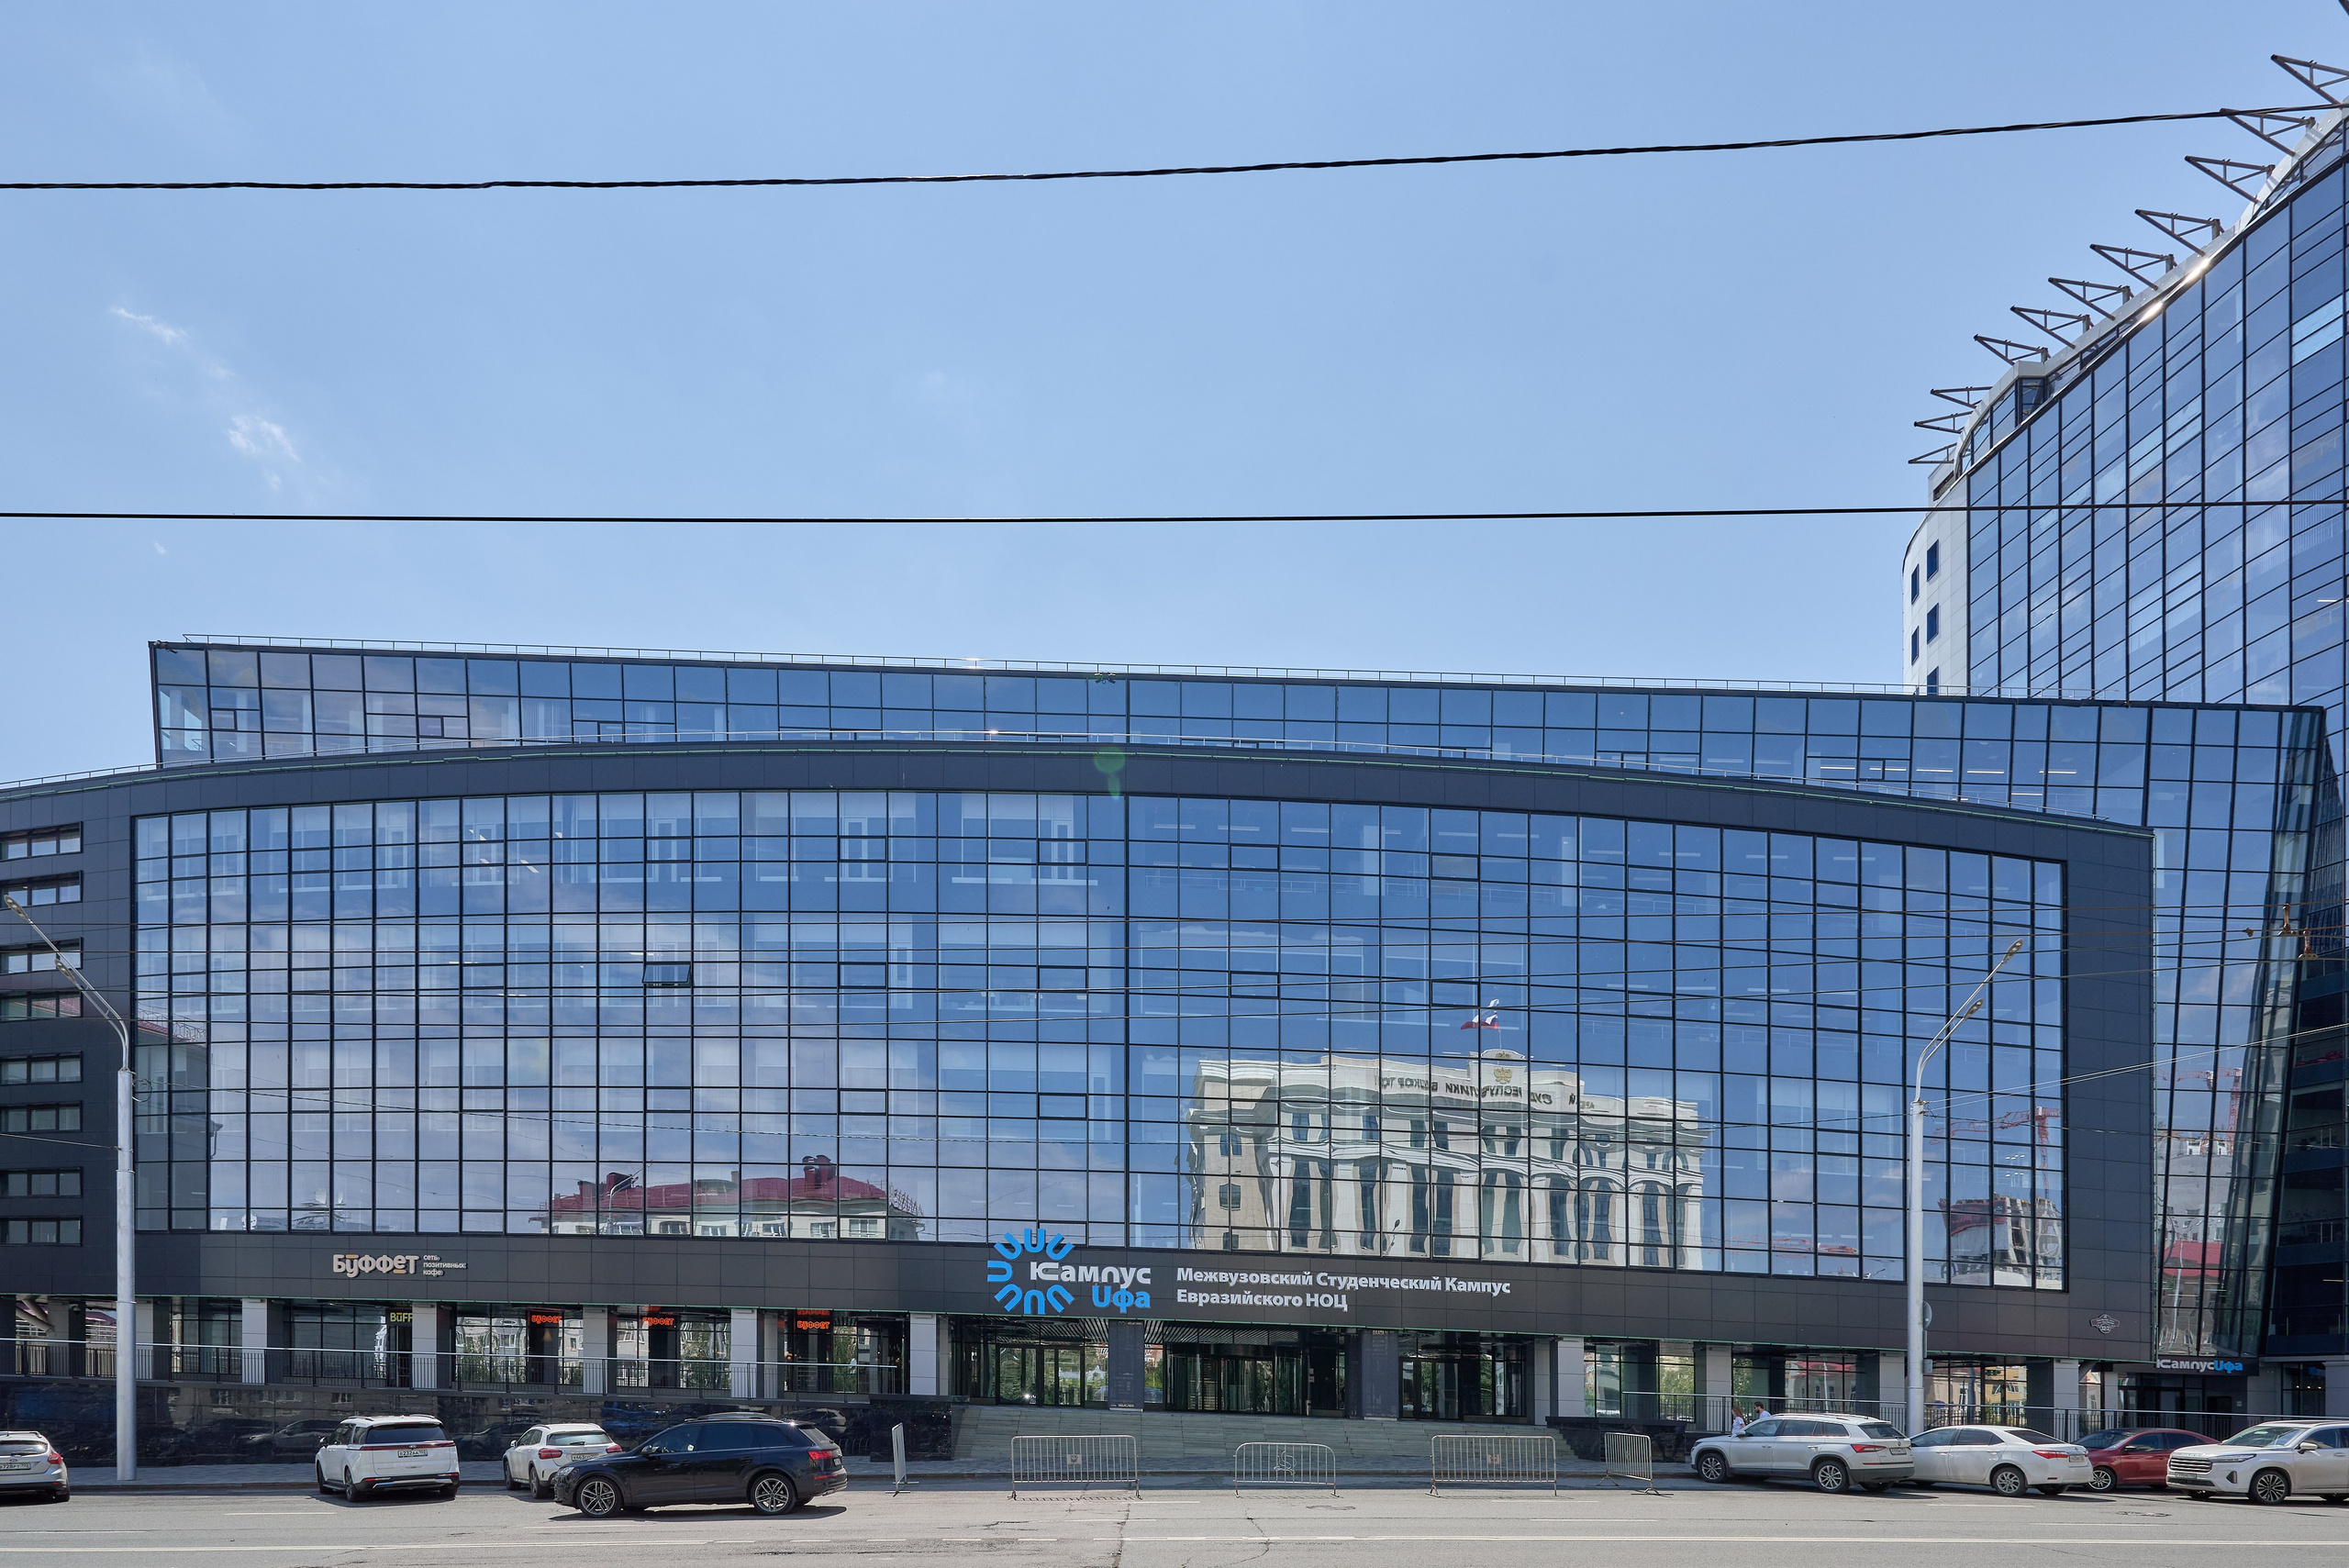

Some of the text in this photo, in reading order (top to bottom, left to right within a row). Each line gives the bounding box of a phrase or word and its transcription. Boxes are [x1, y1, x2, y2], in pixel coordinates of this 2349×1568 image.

[333, 1254, 419, 1277] Буффет
[422, 1268, 444, 1276] кафе
[1030, 1261, 1152, 1289] Кампус
[1176, 1267, 1511, 1297] Межвузовский Студенческий Кампус
[1176, 1289, 1348, 1312] Евразийского НОЦ
